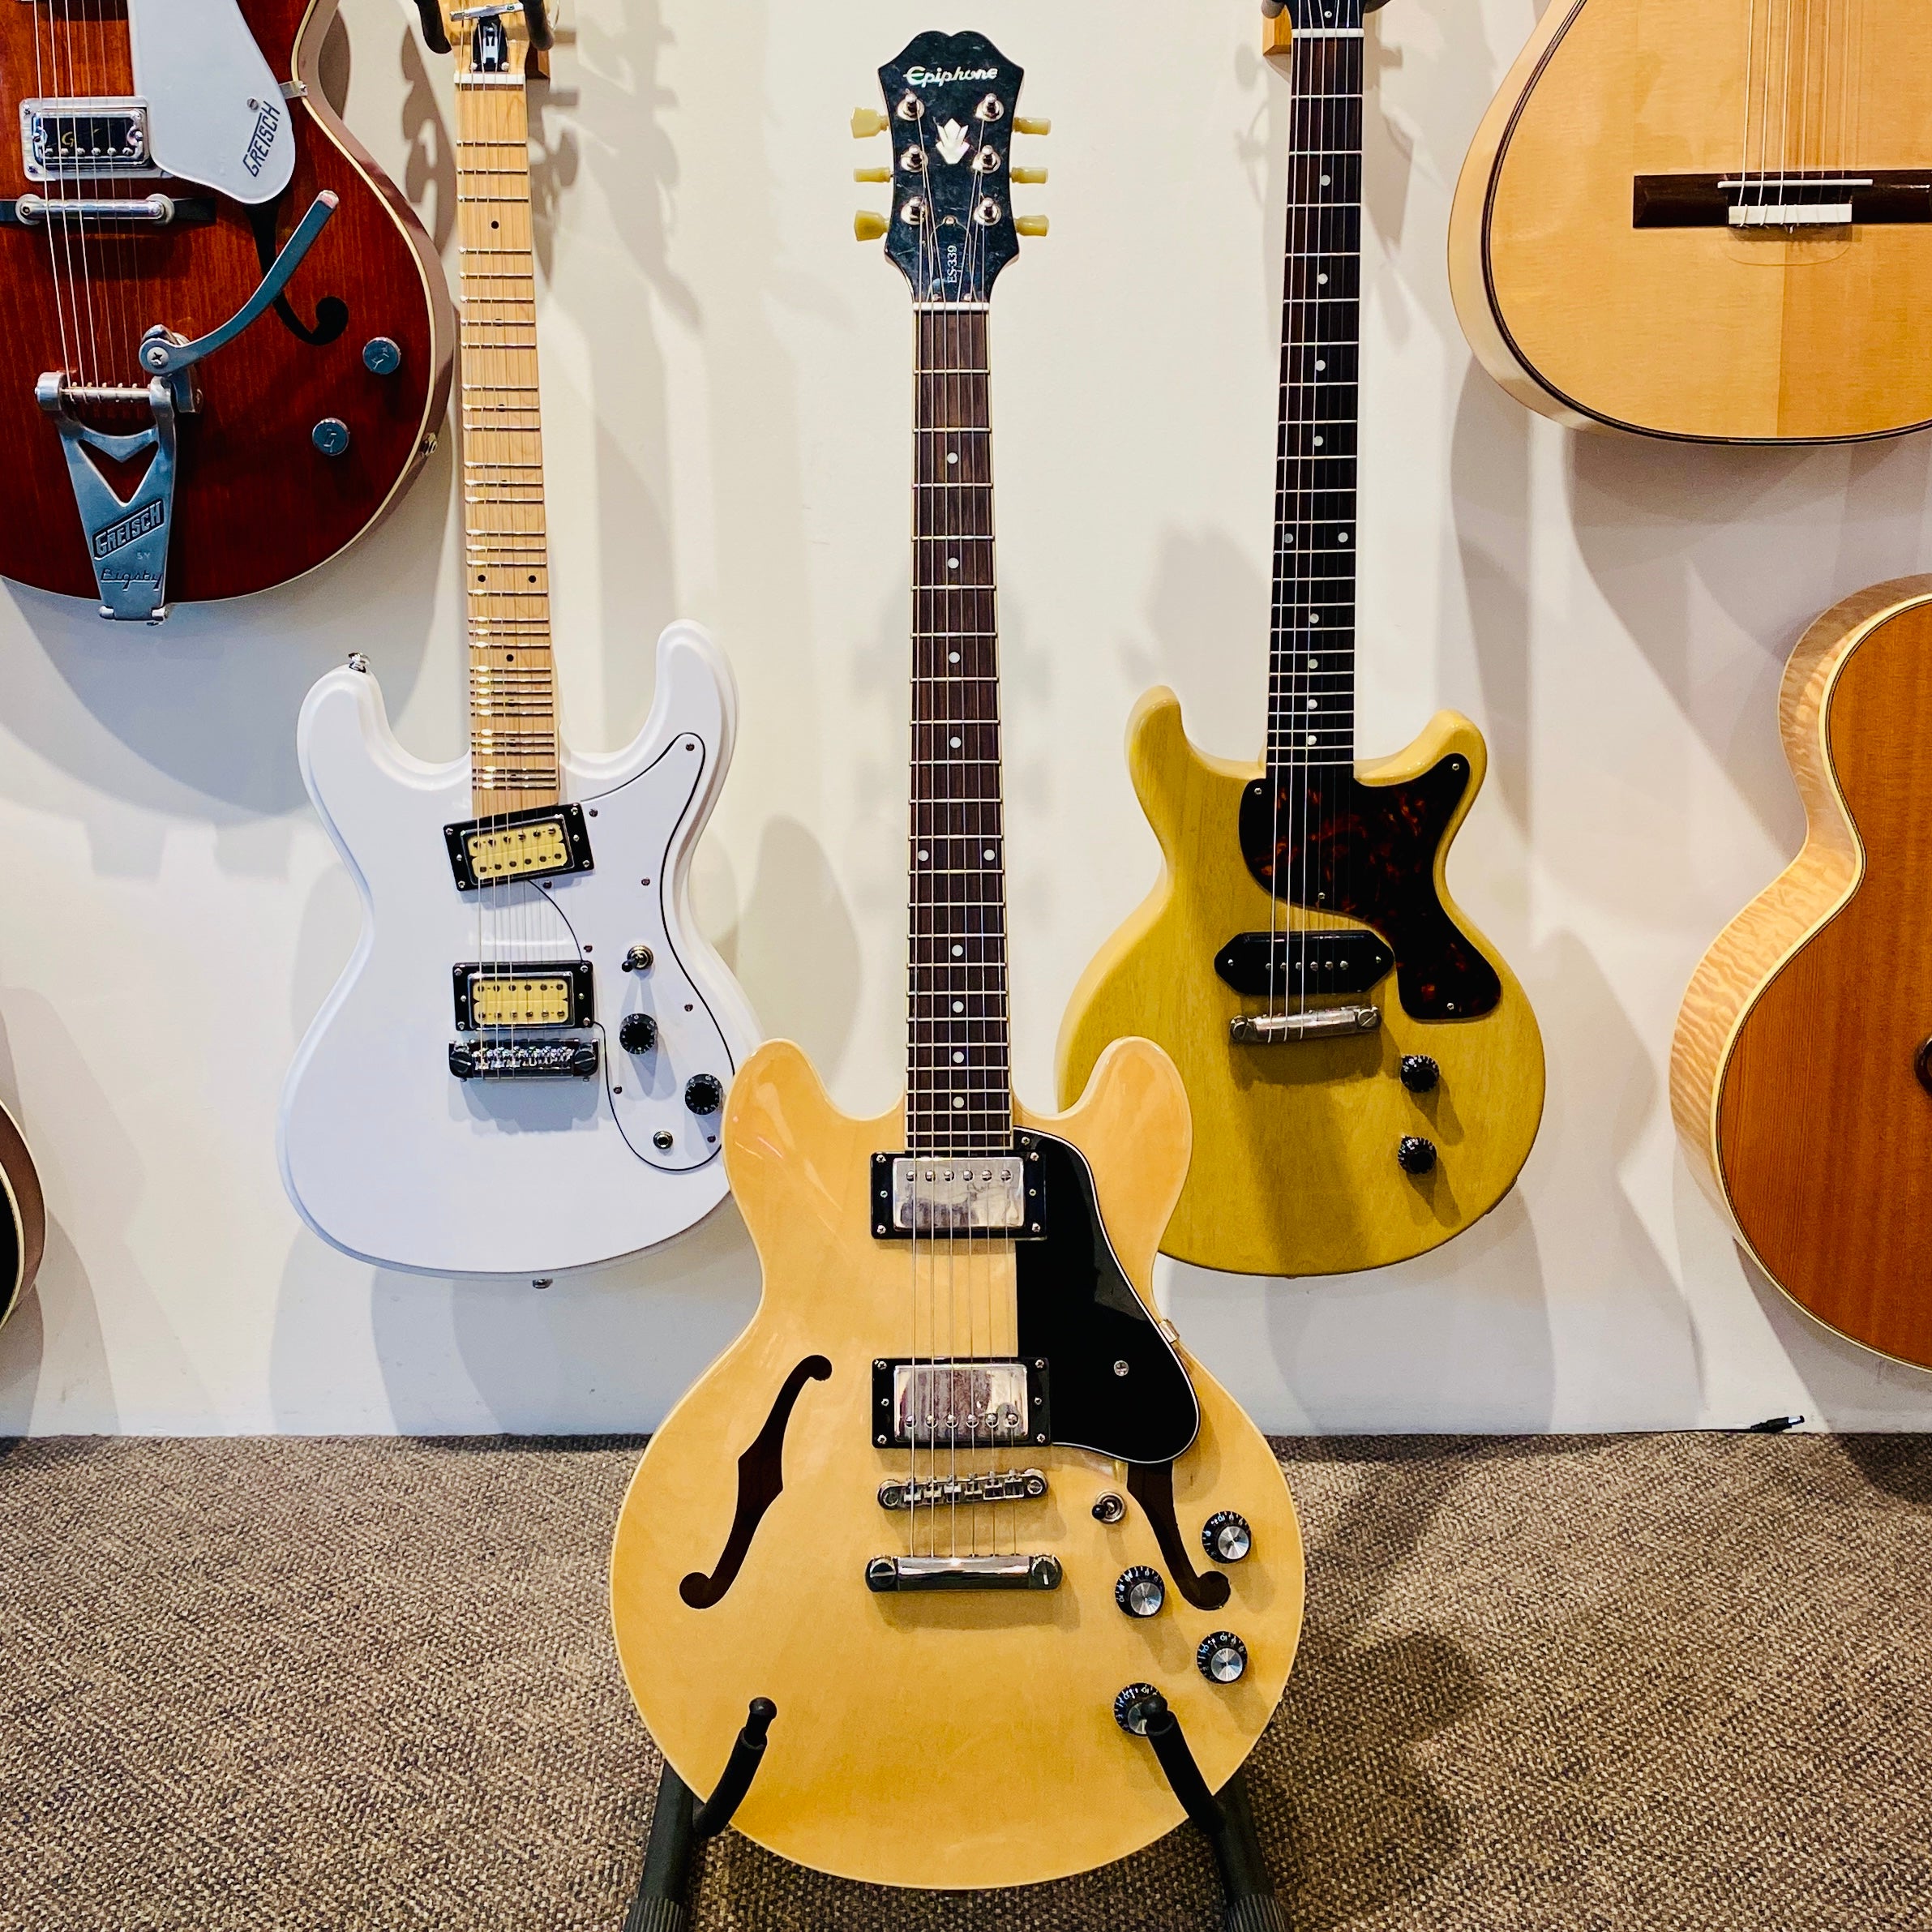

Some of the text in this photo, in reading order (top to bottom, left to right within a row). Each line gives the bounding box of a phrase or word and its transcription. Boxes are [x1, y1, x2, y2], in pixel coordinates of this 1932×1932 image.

[902, 66, 998, 88] Epiphone
[242, 101, 281, 177] GRETSCH
[947, 245, 957, 283] ES-339
[95, 500, 162, 556] GRETSCH
[100, 568, 162, 592] Bigsby
